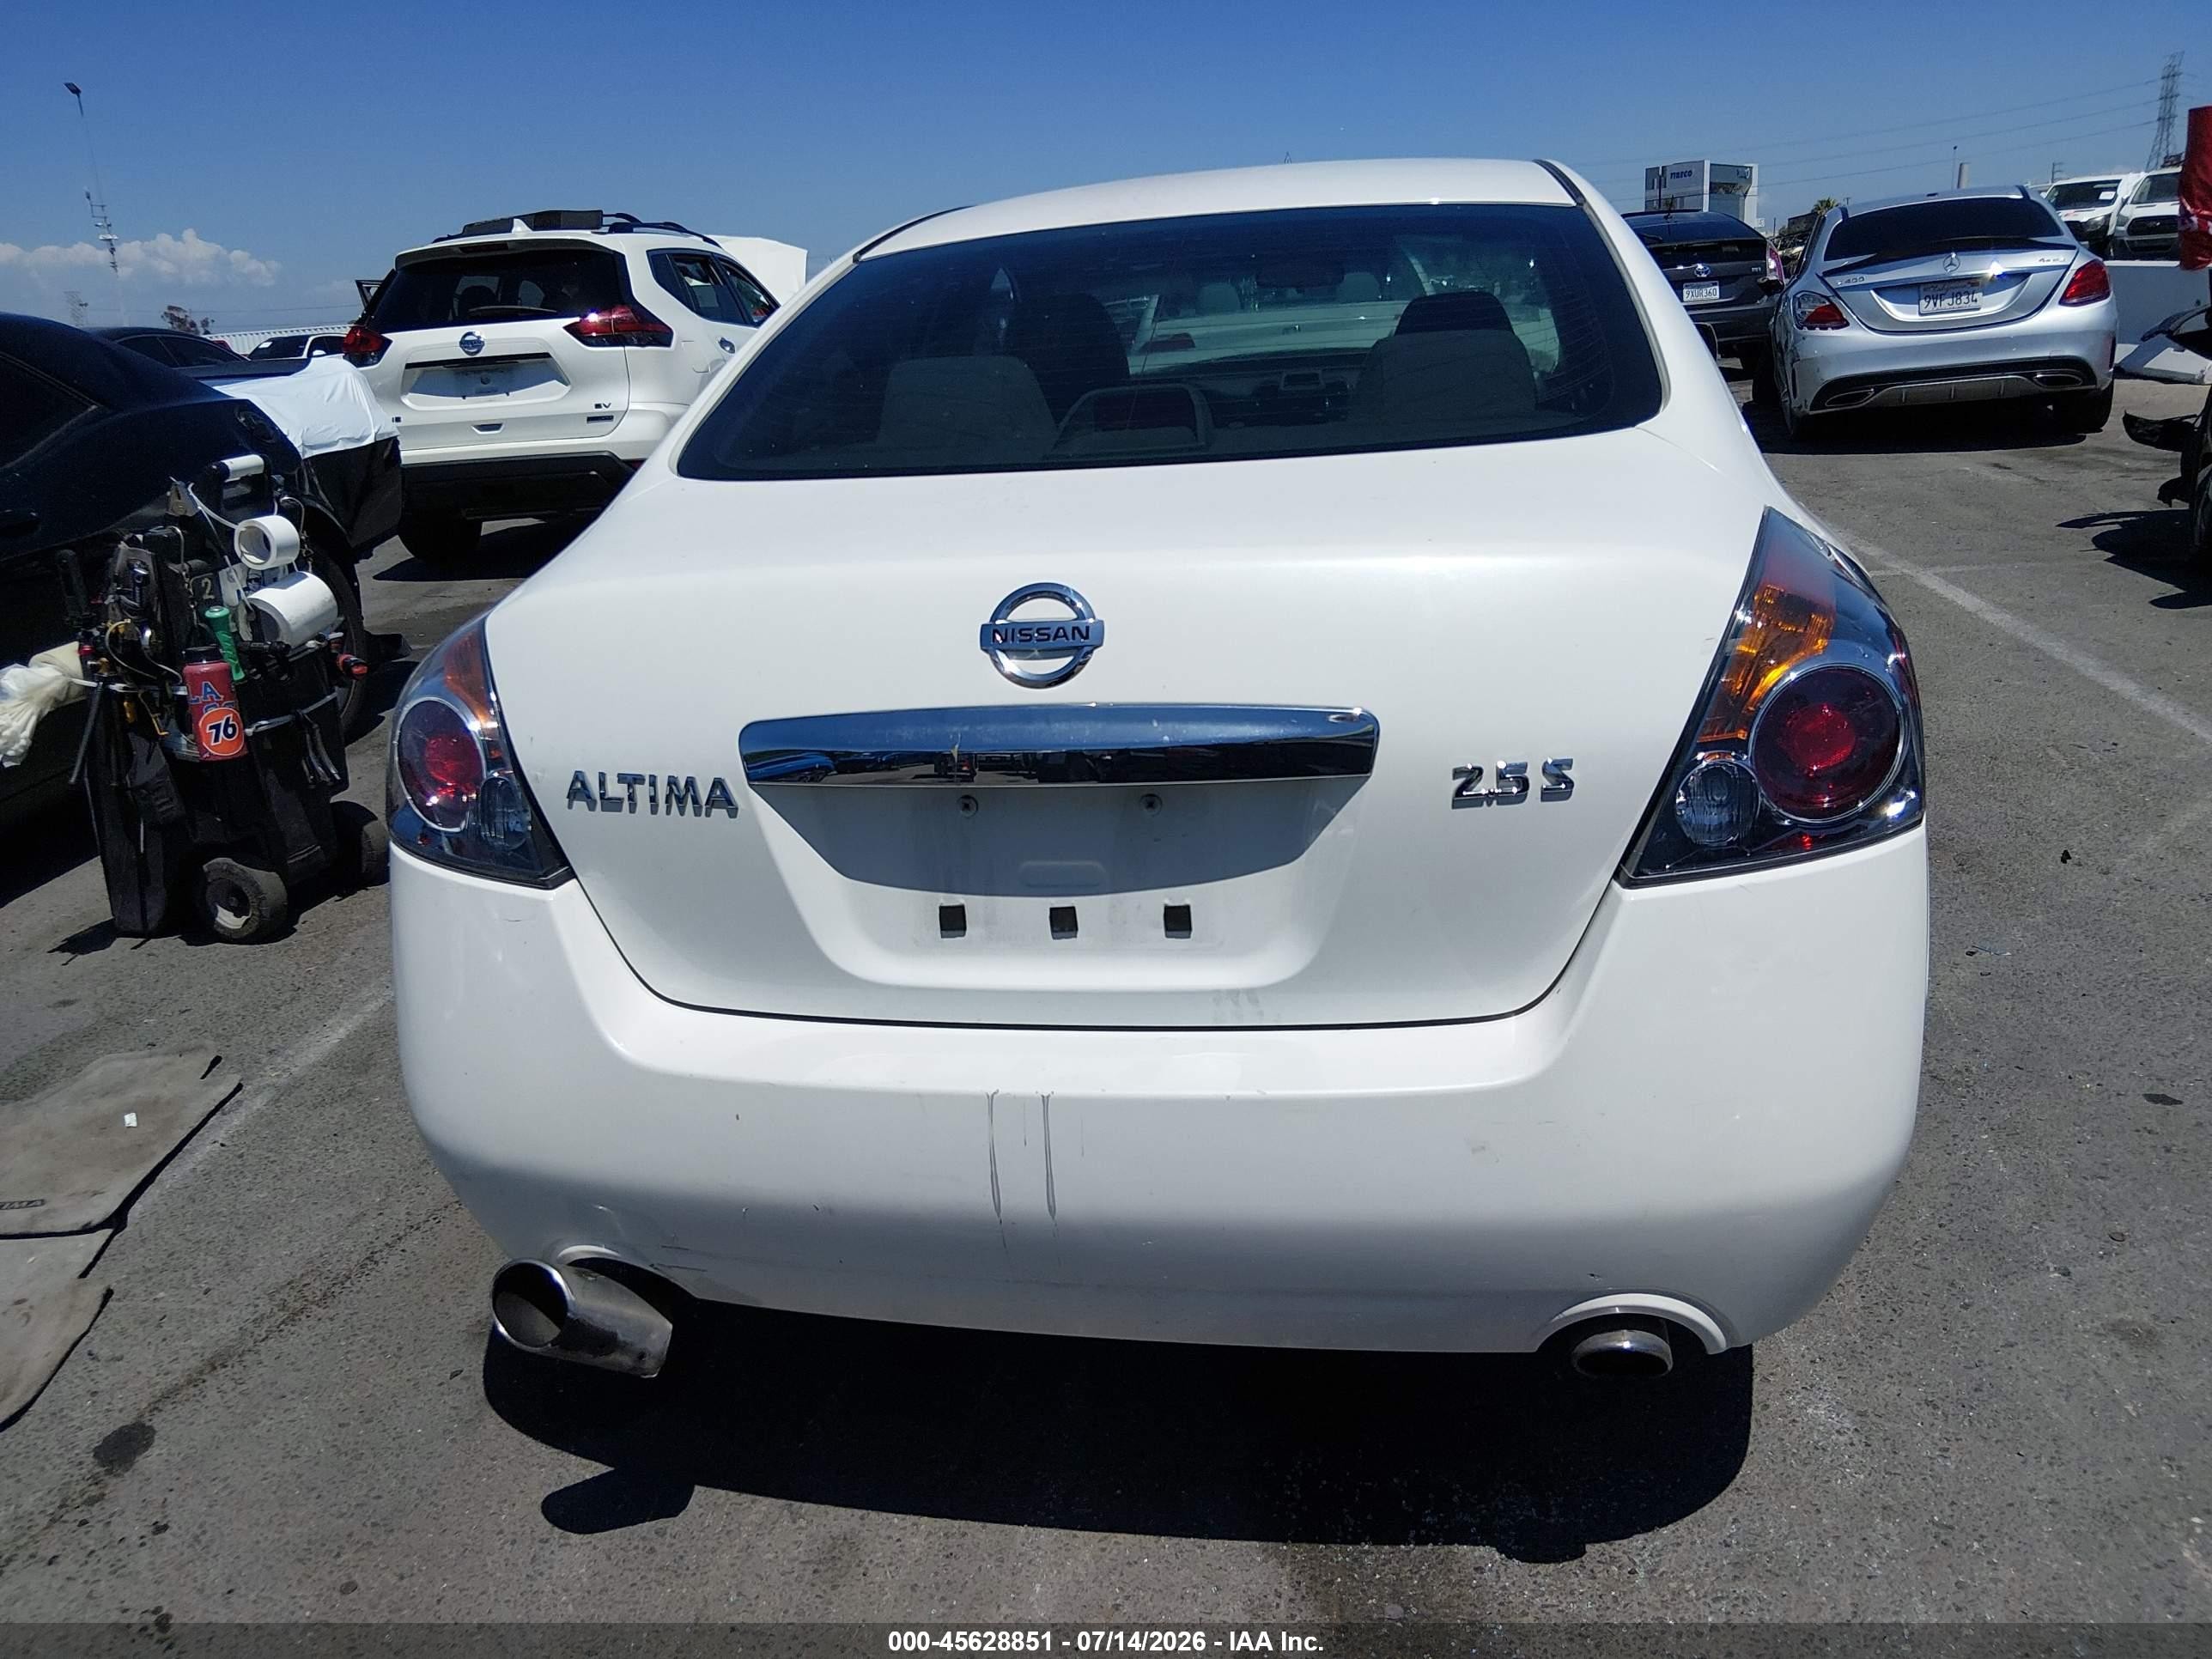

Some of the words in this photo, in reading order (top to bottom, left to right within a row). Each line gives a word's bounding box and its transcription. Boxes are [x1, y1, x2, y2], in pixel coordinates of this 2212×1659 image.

[1686, 289, 1717, 299] 9XUR360
[1924, 291, 1978, 308] 9VFJ834
[992, 625, 1090, 644] NISSAN
[206, 714, 239, 745] 76
[1540, 758, 1574, 802] S
[567, 770, 738, 818] ALTIMA
